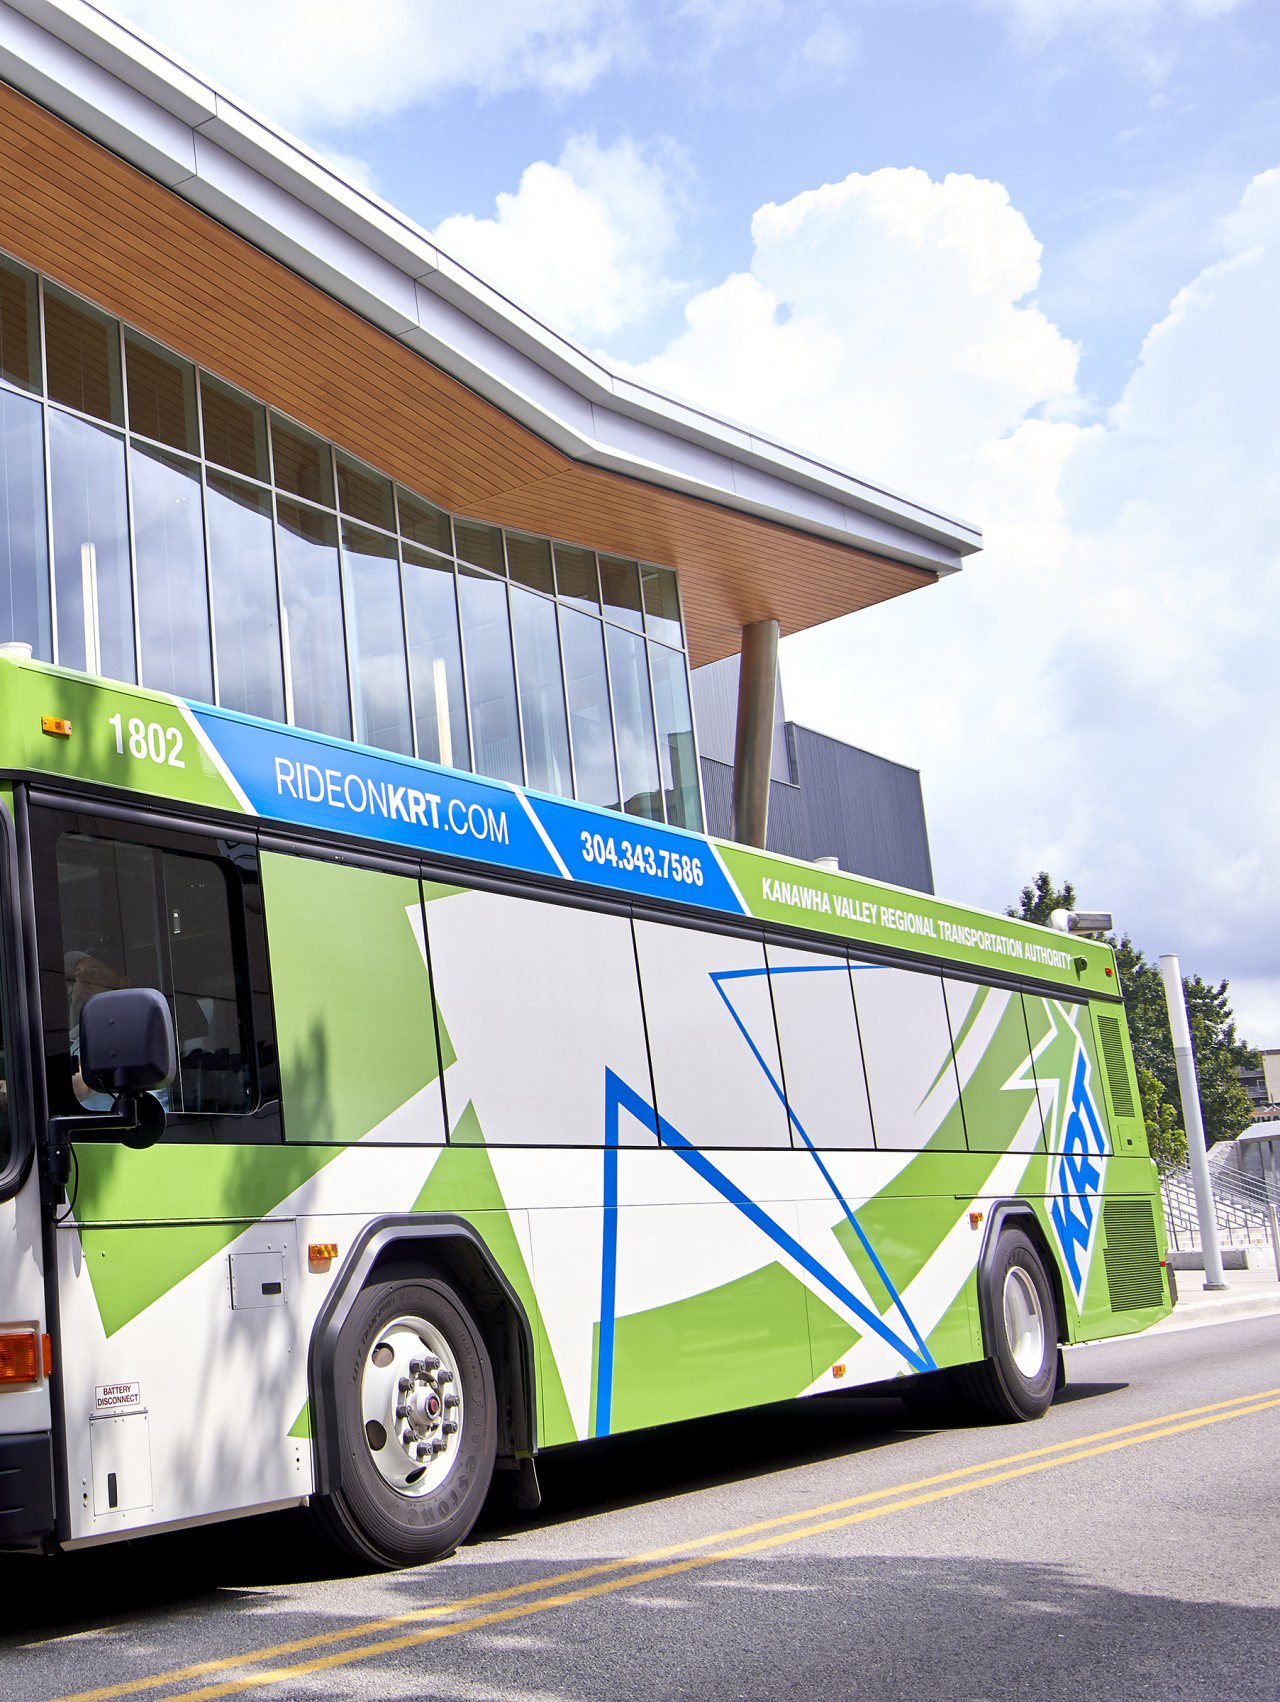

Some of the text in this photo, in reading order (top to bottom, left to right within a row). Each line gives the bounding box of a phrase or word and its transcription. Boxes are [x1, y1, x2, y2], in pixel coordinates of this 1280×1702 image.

[108, 713, 186, 769] 1802
[274, 756, 510, 845] RIDEONKRT.COM
[580, 831, 704, 887] 304.343.7586
[762, 877, 1073, 970] KANAWHA VALLEY REGIONAL TRANSPORTATION AUTHORITY
[1051, 1046, 1107, 1297] KRT
[97, 1394, 139, 1407] DISCONNECT
[103, 1385, 132, 1396] BATTERY
